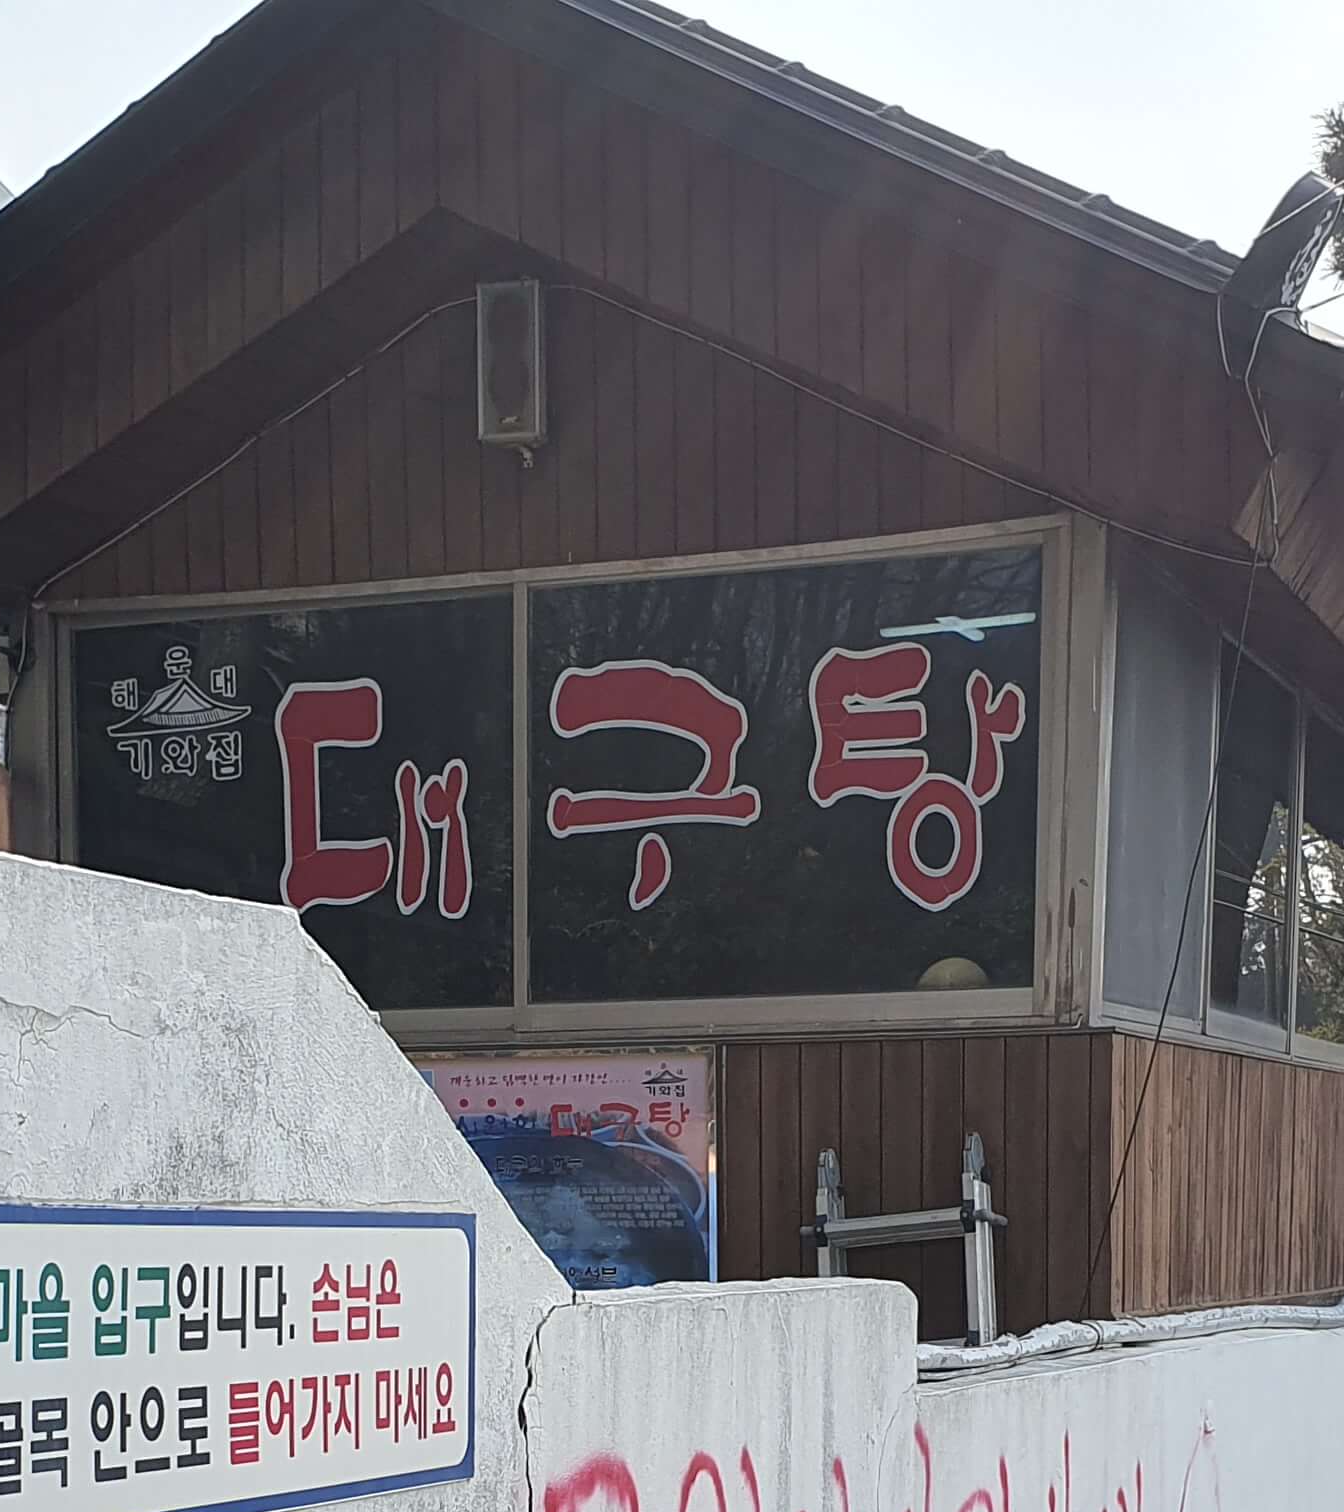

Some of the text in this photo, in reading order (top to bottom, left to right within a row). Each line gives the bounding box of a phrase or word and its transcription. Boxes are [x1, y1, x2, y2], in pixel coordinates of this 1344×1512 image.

[117, 730, 242, 780] 기와집
[275, 641, 1027, 919] 대구탕
[92, 1262, 296, 1357] 입구입니다.
[311, 1258, 402, 1344] 손님은
[90, 1385, 211, 1482] 안으로
[227, 1372, 361, 1466] 들어가지
[374, 1361, 457, 1444] 마세요
